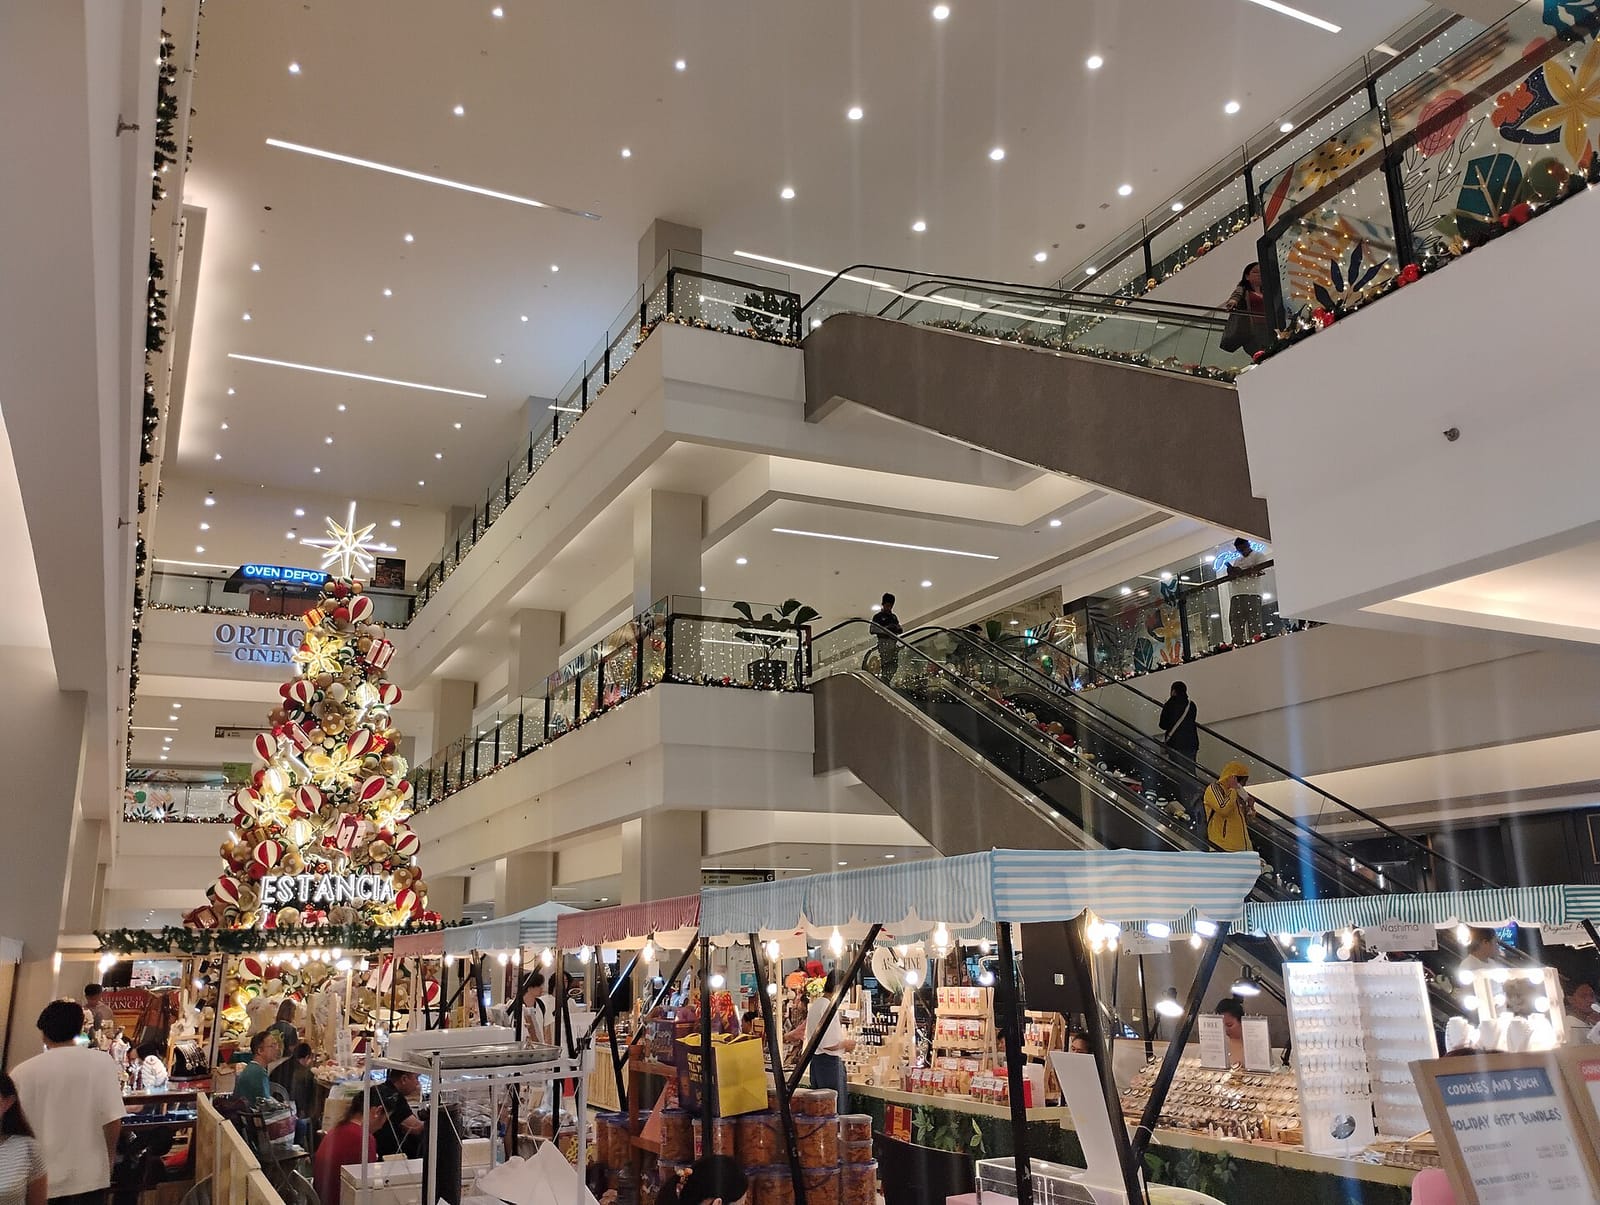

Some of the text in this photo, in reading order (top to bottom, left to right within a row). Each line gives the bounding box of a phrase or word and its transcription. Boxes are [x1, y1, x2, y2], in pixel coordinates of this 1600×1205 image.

[245, 565, 328, 582] OVEN DEPOT
[766, 873, 774, 881] G
[260, 874, 396, 903] ESTANCIA
[1447, 1079, 1489, 1096] COOKIES
[1492, 1078, 1512, 1093] AND
